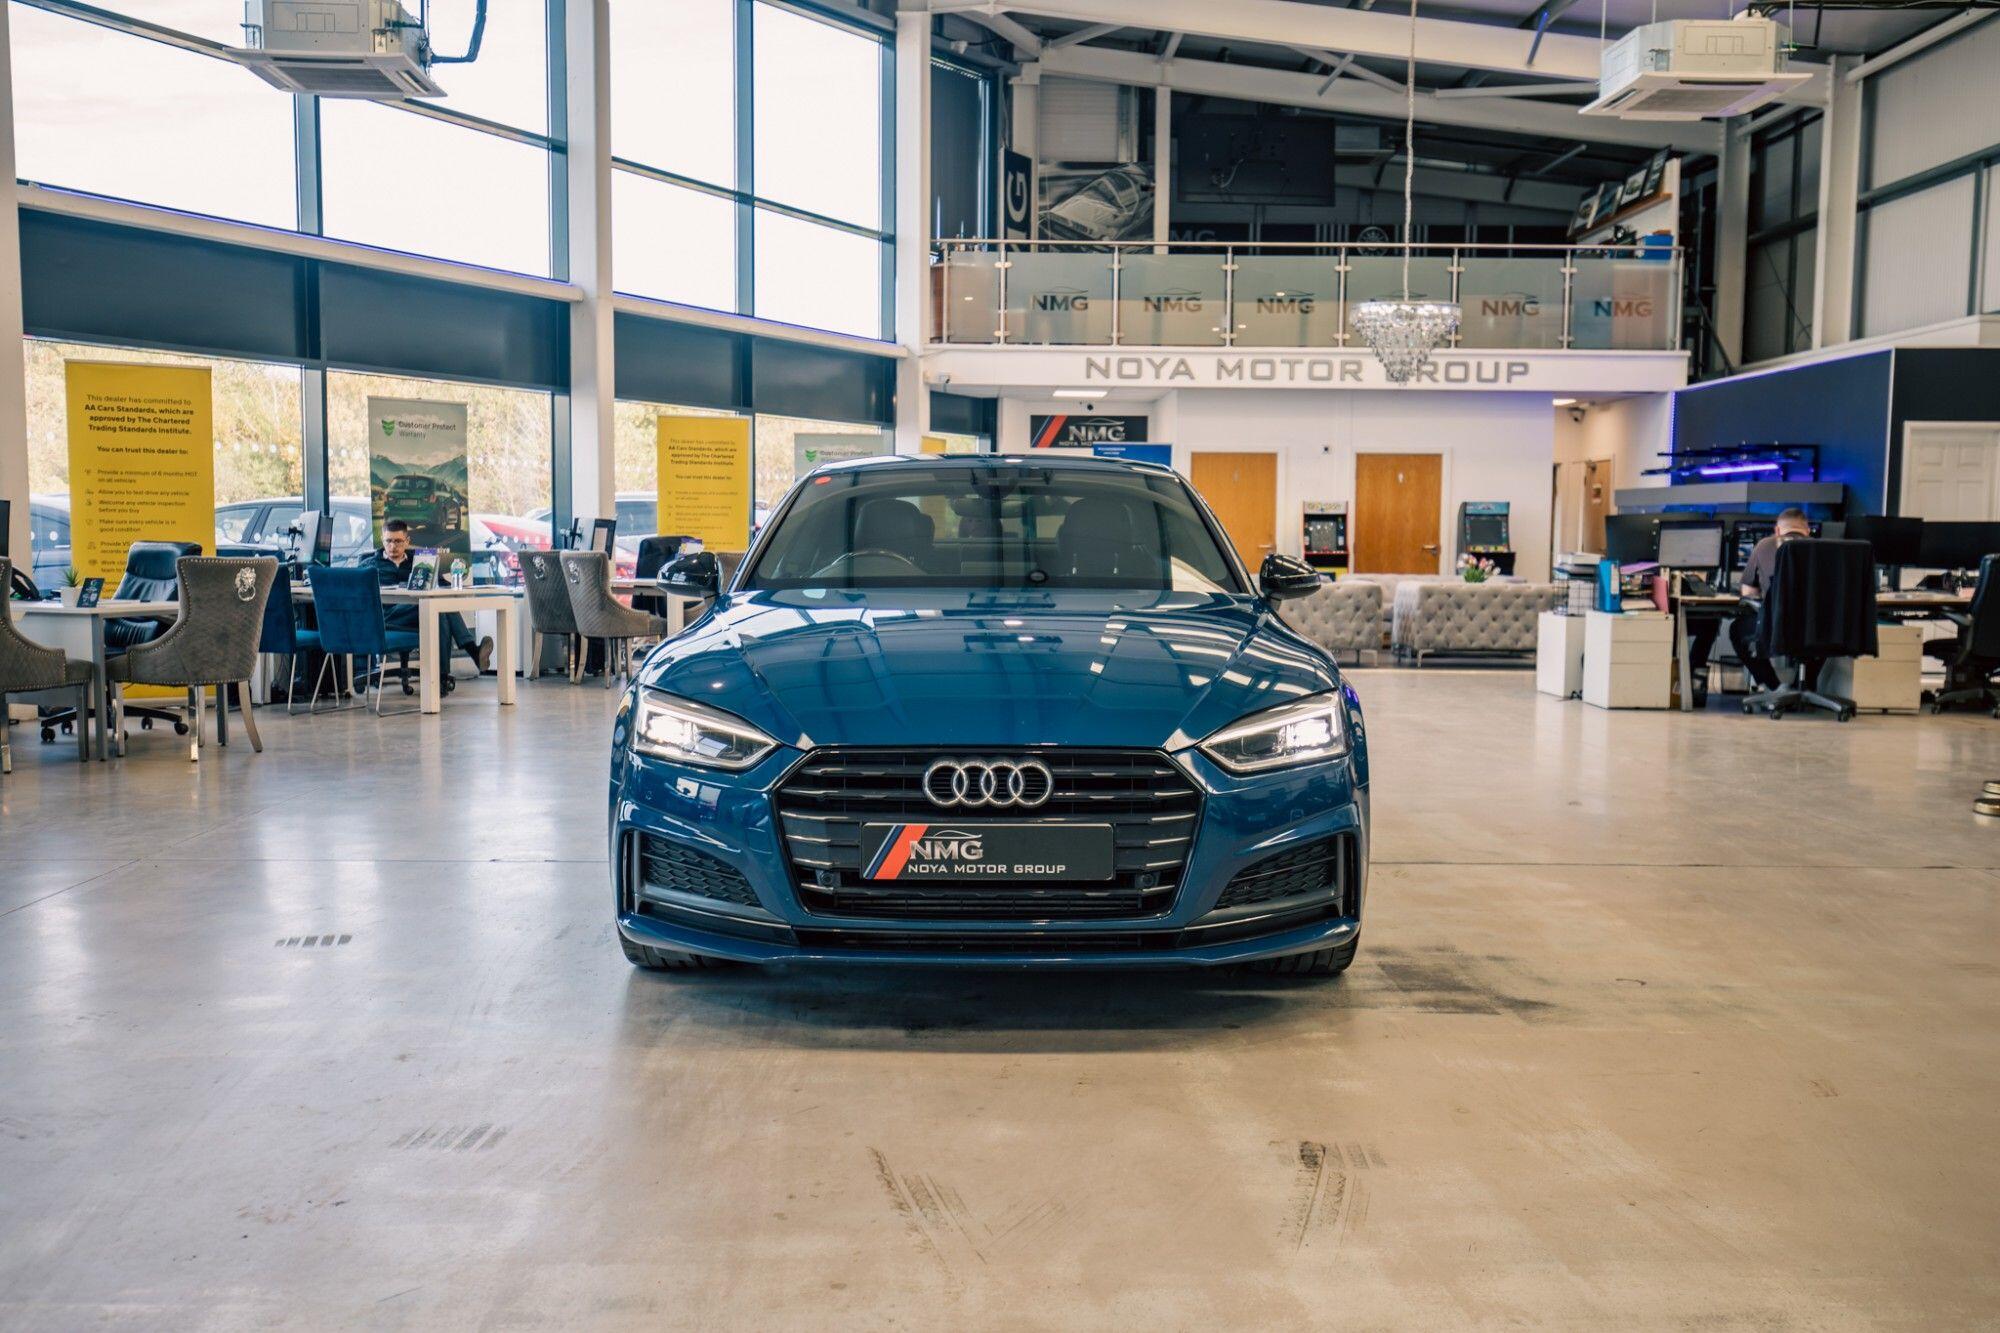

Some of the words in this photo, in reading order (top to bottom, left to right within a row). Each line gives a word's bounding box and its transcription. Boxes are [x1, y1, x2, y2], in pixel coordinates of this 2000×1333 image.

[1032, 295, 1088, 310] NMG
[1144, 296, 1202, 312] NMG
[1256, 298, 1315, 314] NMG
[1482, 300, 1540, 316] NMG
[1594, 301, 1652, 316] NMG
[1086, 357, 1195, 380] NOYA
[1217, 358, 1364, 382] MOTOR
[116, 406, 157, 414] Standards,
[88, 424, 116, 433] Trading
[398, 421, 430, 429] Customer
[432, 422, 456, 431] Protect
[1068, 426, 1126, 441] NMG
[910, 840, 984, 860] NMG
[908, 864, 948, 874] NOYA
[954, 864, 1007, 874] MOTOR
[1014, 864, 1066, 874] GROUP
